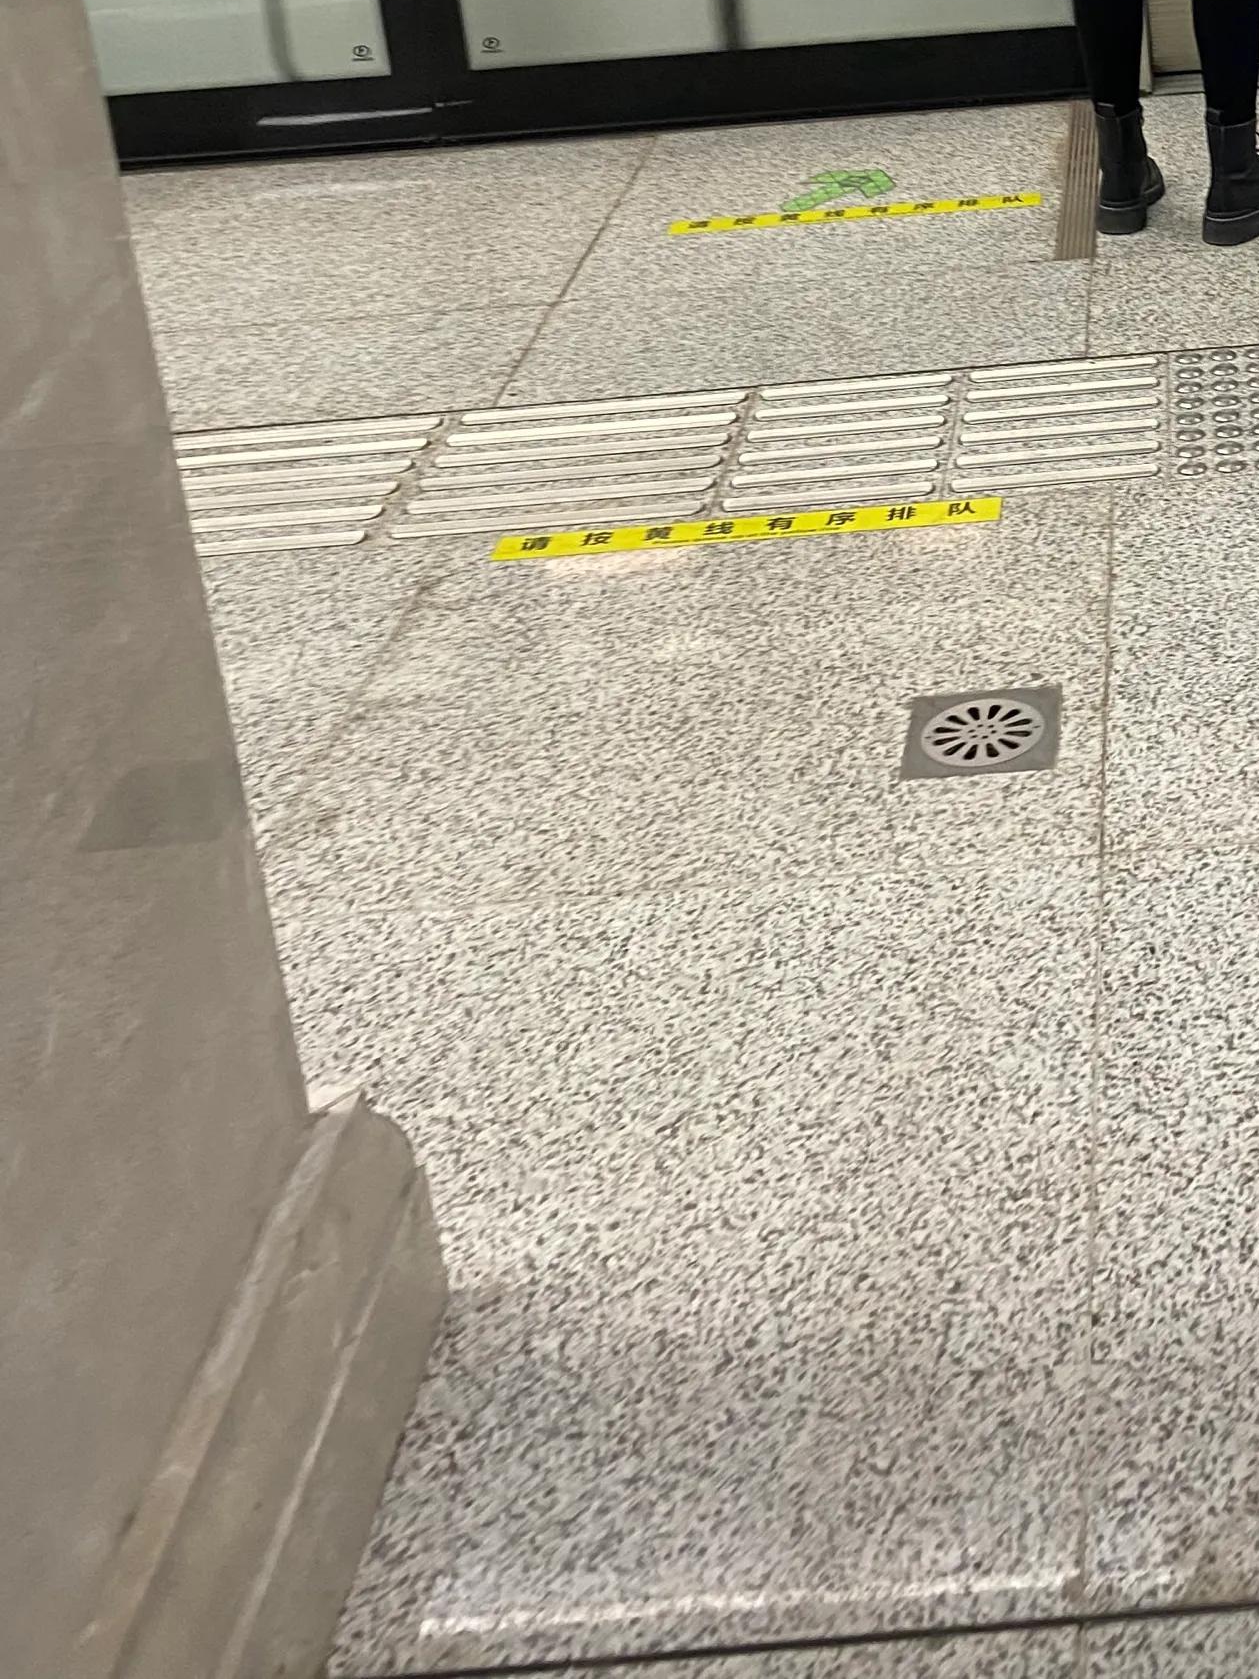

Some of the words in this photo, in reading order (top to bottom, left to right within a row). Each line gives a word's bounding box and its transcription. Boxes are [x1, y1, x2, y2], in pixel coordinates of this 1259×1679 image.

[519, 500, 977, 553] 请按黄线有序排队
